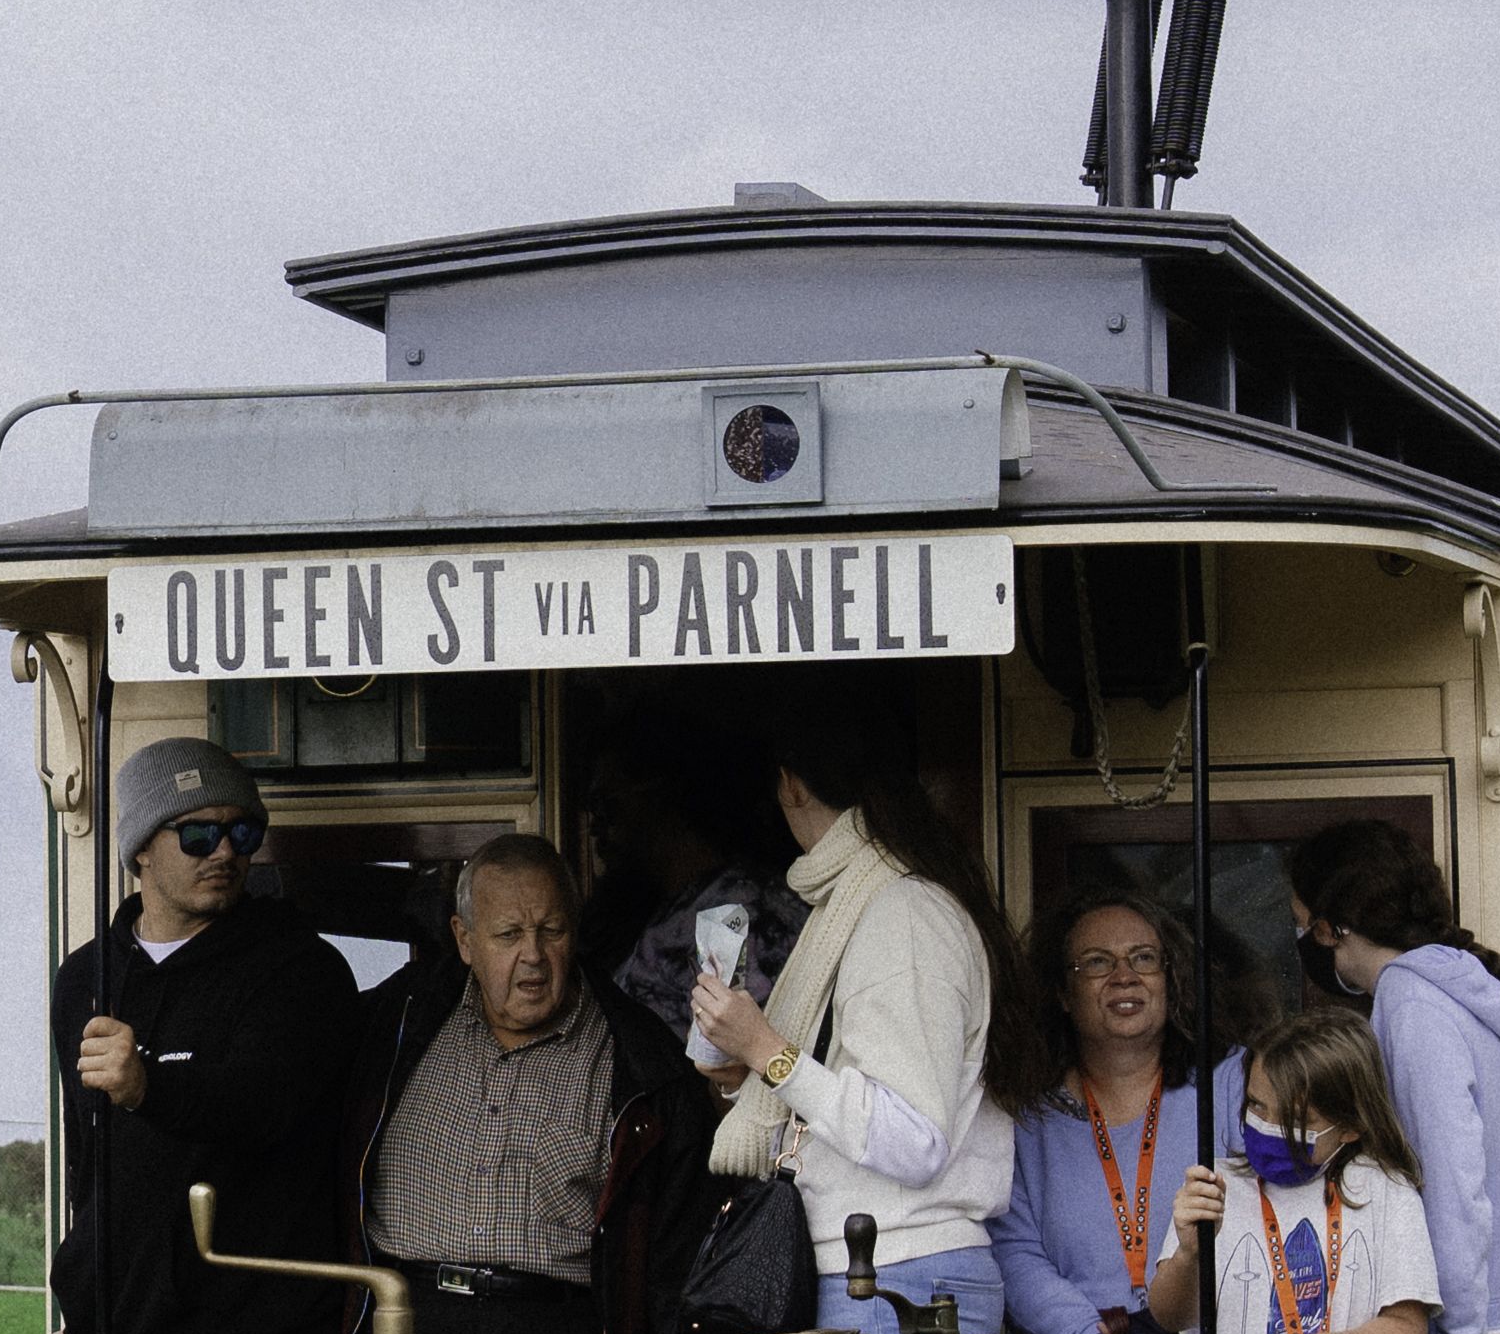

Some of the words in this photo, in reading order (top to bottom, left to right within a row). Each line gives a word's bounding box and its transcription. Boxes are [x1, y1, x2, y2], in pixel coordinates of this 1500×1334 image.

[167, 563, 383, 675] QUEEN
[427, 559, 505, 665] ST
[534, 581, 595, 636] VIA
[627, 544, 948, 658] PARNELL
